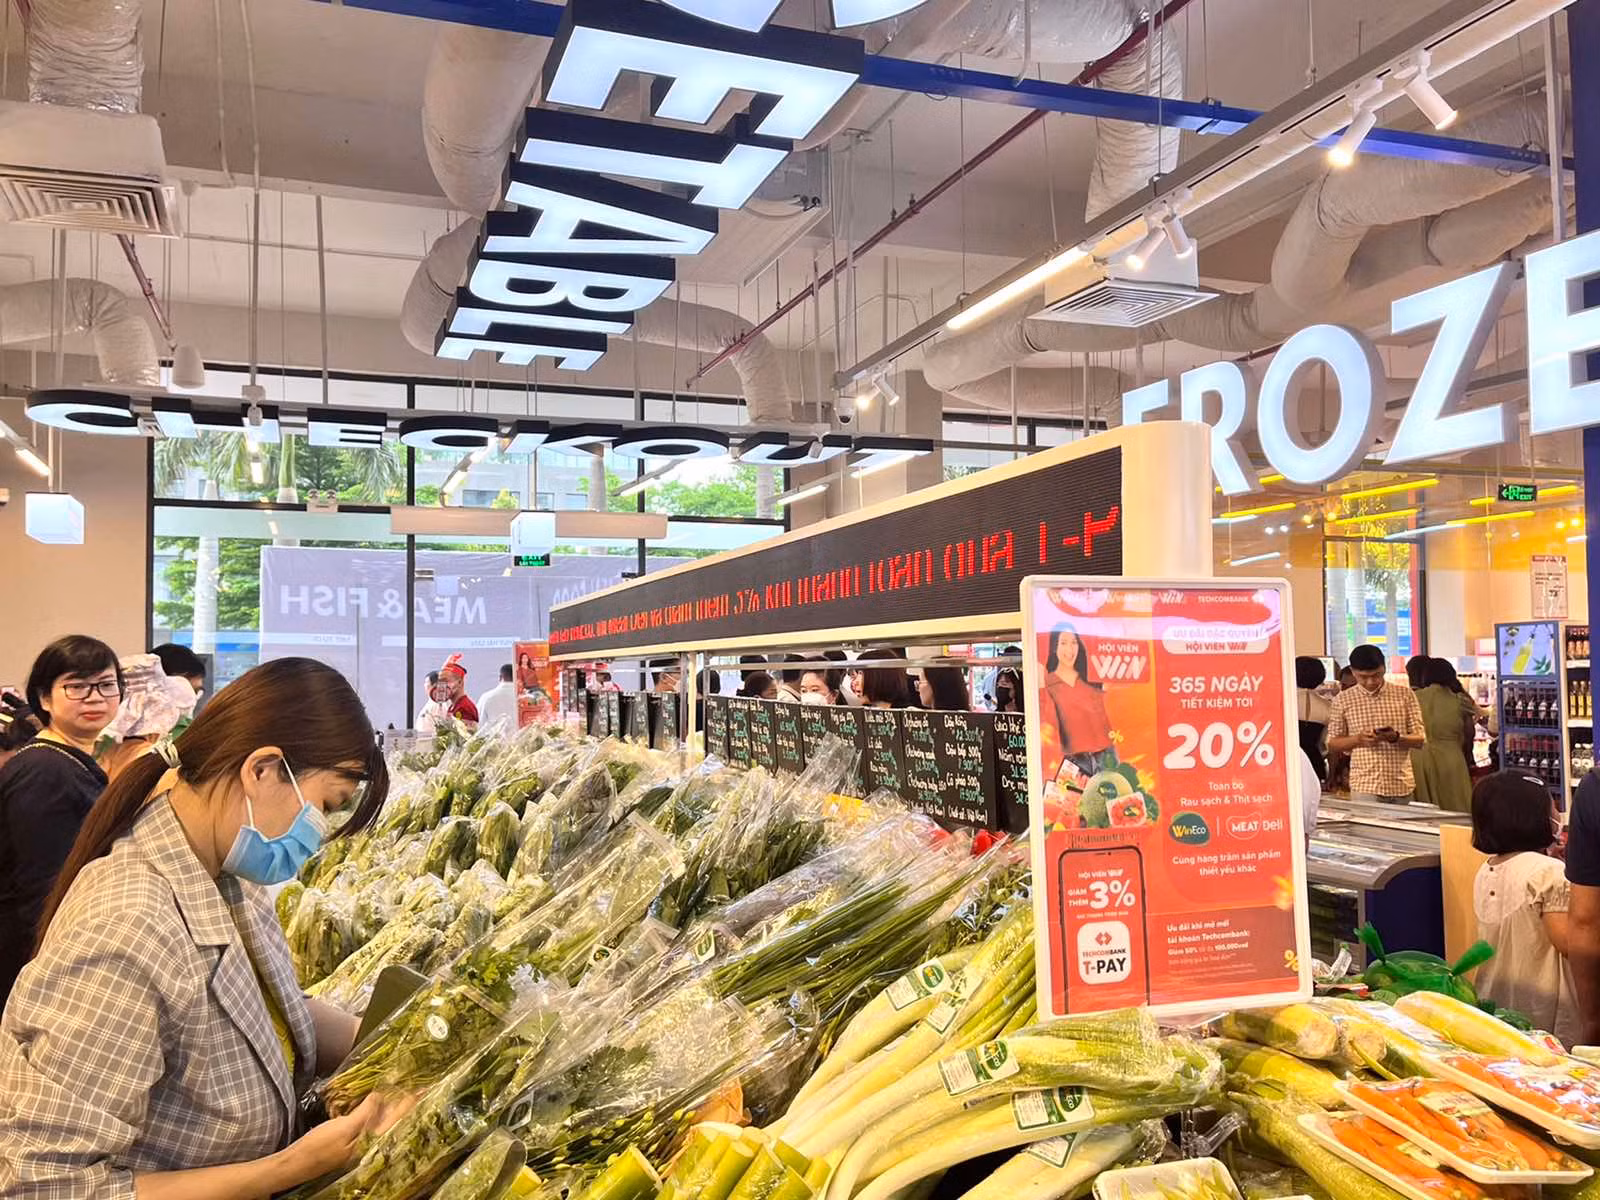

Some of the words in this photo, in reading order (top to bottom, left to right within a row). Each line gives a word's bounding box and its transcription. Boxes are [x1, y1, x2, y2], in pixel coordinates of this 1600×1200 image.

[435, 0, 905, 371] ETABLE
[25, 390, 934, 470] CHECKOUT
[1098, 643, 1118, 654] HỘI
[1120, 642, 1139, 653] VIÊN
[1169, 676, 1206, 693] 365
[1210, 672, 1264, 693] NGÀY
[1180, 695, 1203, 709] TIẾT
[1206, 695, 1233, 709] KIỆM
[1236, 695, 1254, 708] TỚI
[1163, 720, 1275, 769] 20%
[1180, 797, 1199, 807] Rau
[1231, 821, 1259, 832] MEAT
[1089, 880, 1136, 909] 3%
[1082, 948, 1127, 957] TECHCOMBANK
[1083, 957, 1127, 975] T-PAY
